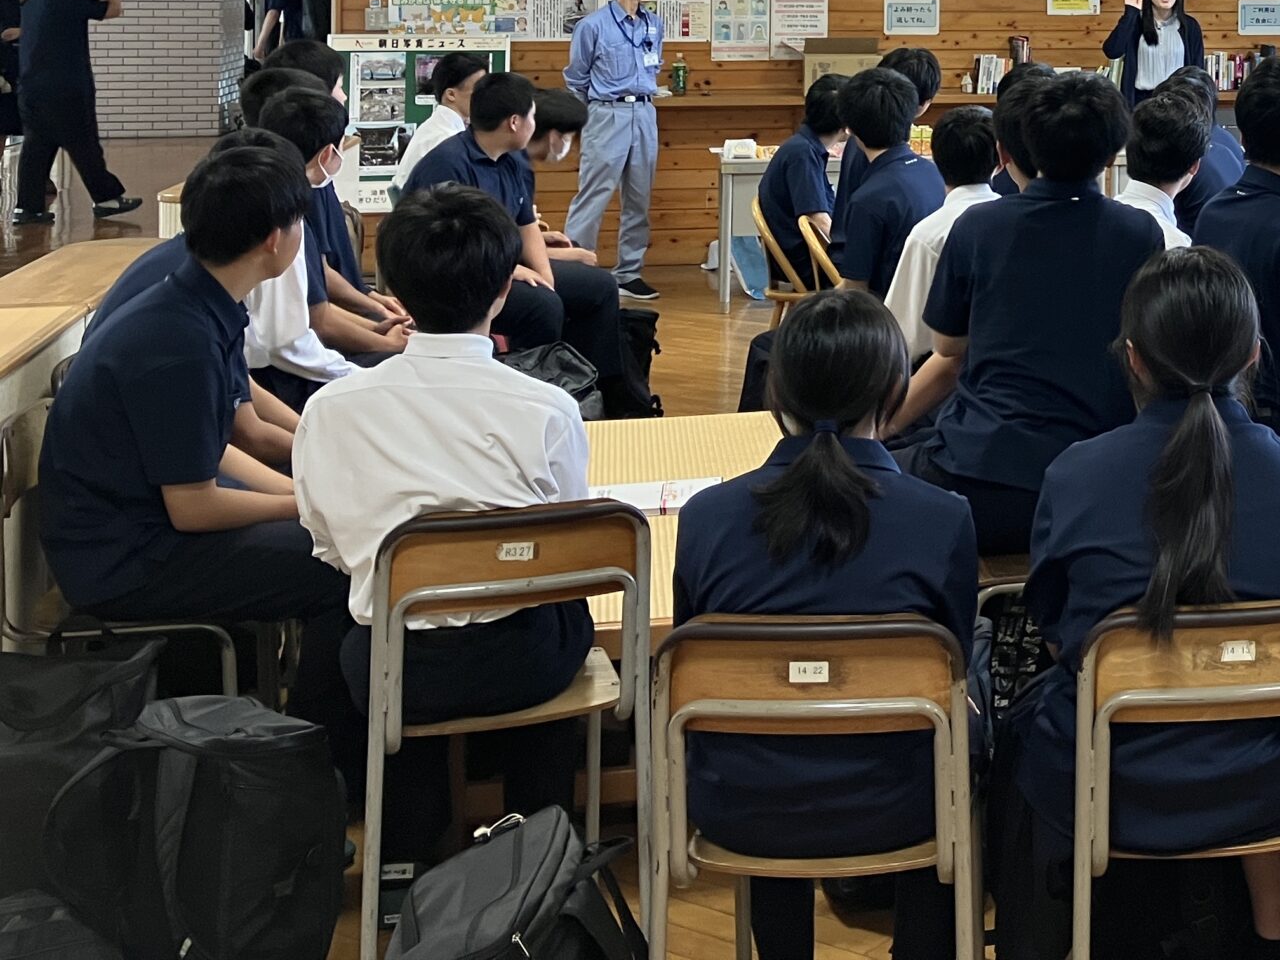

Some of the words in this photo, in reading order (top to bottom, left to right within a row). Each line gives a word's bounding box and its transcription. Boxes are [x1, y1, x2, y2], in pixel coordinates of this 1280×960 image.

[378, 38, 465, 49] 朝日写真ニュース
